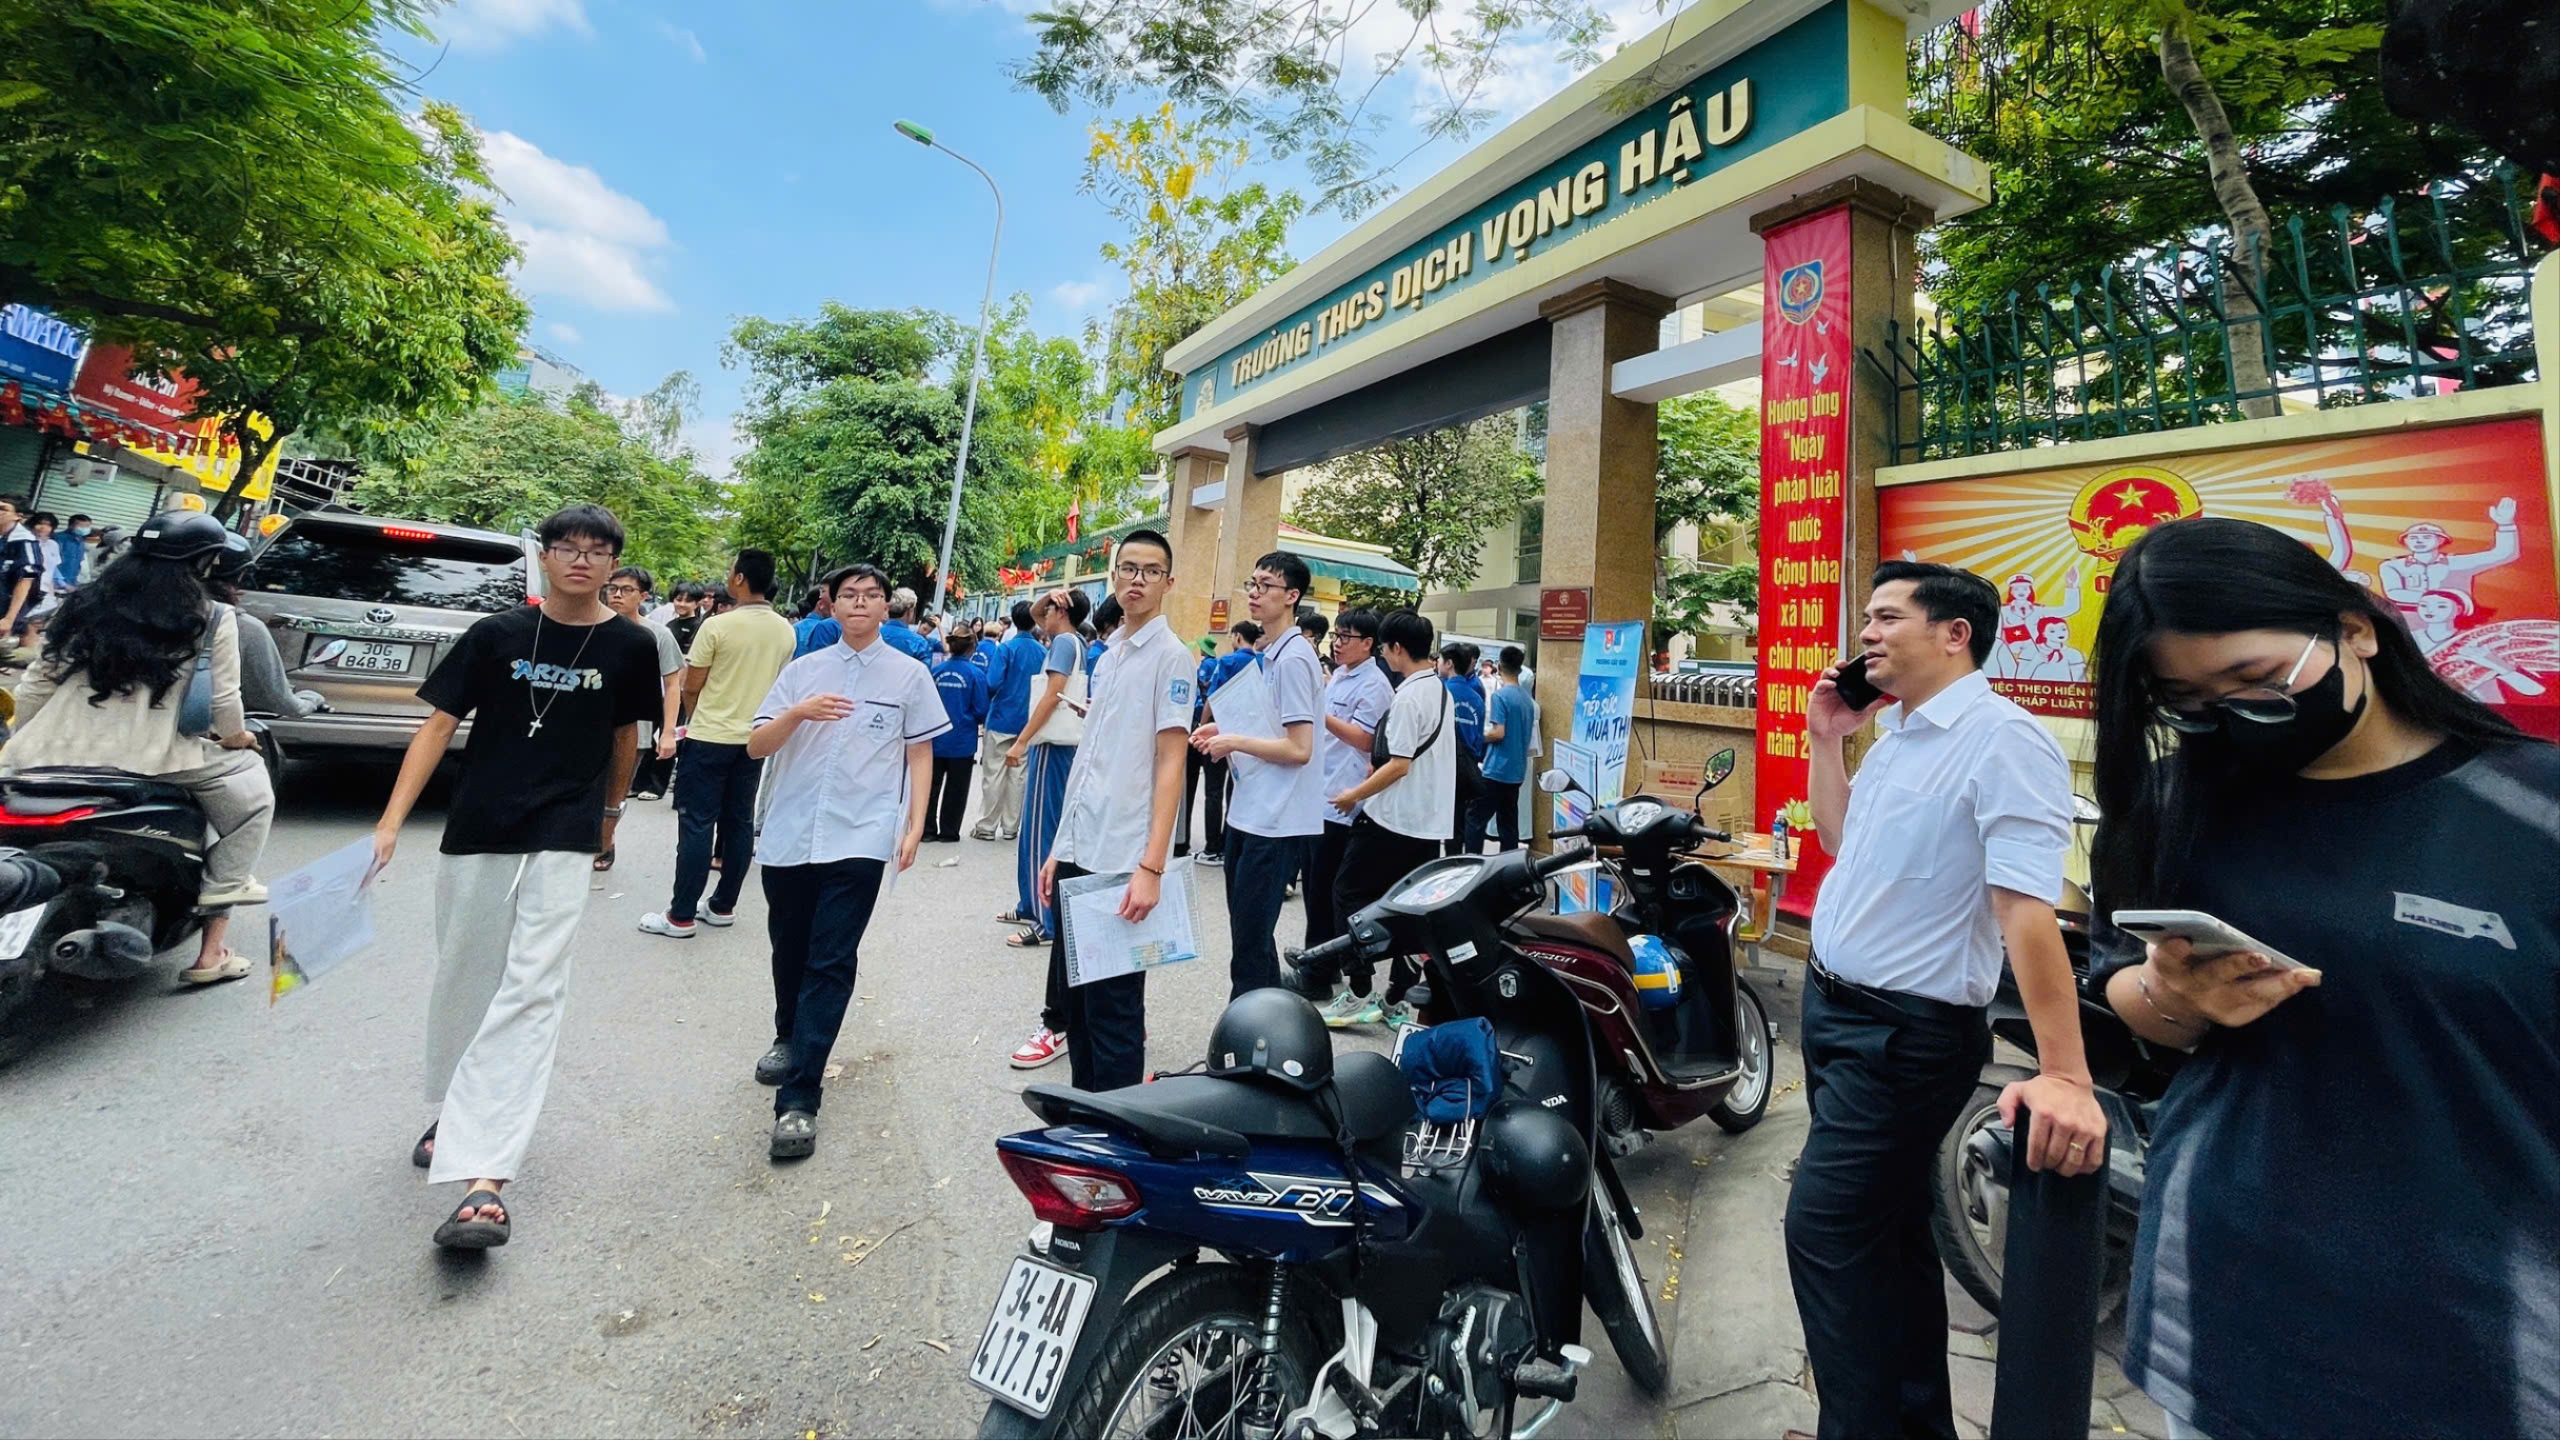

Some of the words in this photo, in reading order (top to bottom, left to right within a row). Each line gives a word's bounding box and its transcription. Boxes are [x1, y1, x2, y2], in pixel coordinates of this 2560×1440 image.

[1317, 281, 1386, 346] THCS
[1391, 232, 1472, 309] DỊCH
[1482, 161, 1607, 262] VỌNG
[1619, 77, 1752, 194] HẬU
[1812, 389, 1840, 417] ứng
[1775, 474, 1807, 507] pháp
[1811, 469, 1840, 504] luật
[1788, 513, 1821, 543] nước
[1774, 556, 1807, 591] Cộng
[1811, 554, 1840, 584] hòa
[1780, 599, 1797, 627] xã
[1801, 597, 1823, 634] hội
[345, 656, 402, 670] 848.38
[362, 643, 393, 656] 30G
[1769, 638, 1792, 670] chủ
[1583, 693, 1600, 718] TIẾP
[1601, 692, 1618, 716] SỨC
[1767, 683, 1792, 719] Việt
[2014, 696, 2047, 707] PHÁP
[2051, 698, 2085, 710] LUẬT
[2017, 683, 2051, 694] THEO
[2054, 684, 2086, 697] HIẾN
[1766, 726, 1796, 758] năm
[1194, 1187, 1274, 1204] WAVE
[1054, 1237, 1081, 1251] HONDA
[977, 1321, 1063, 1403] 417.13
